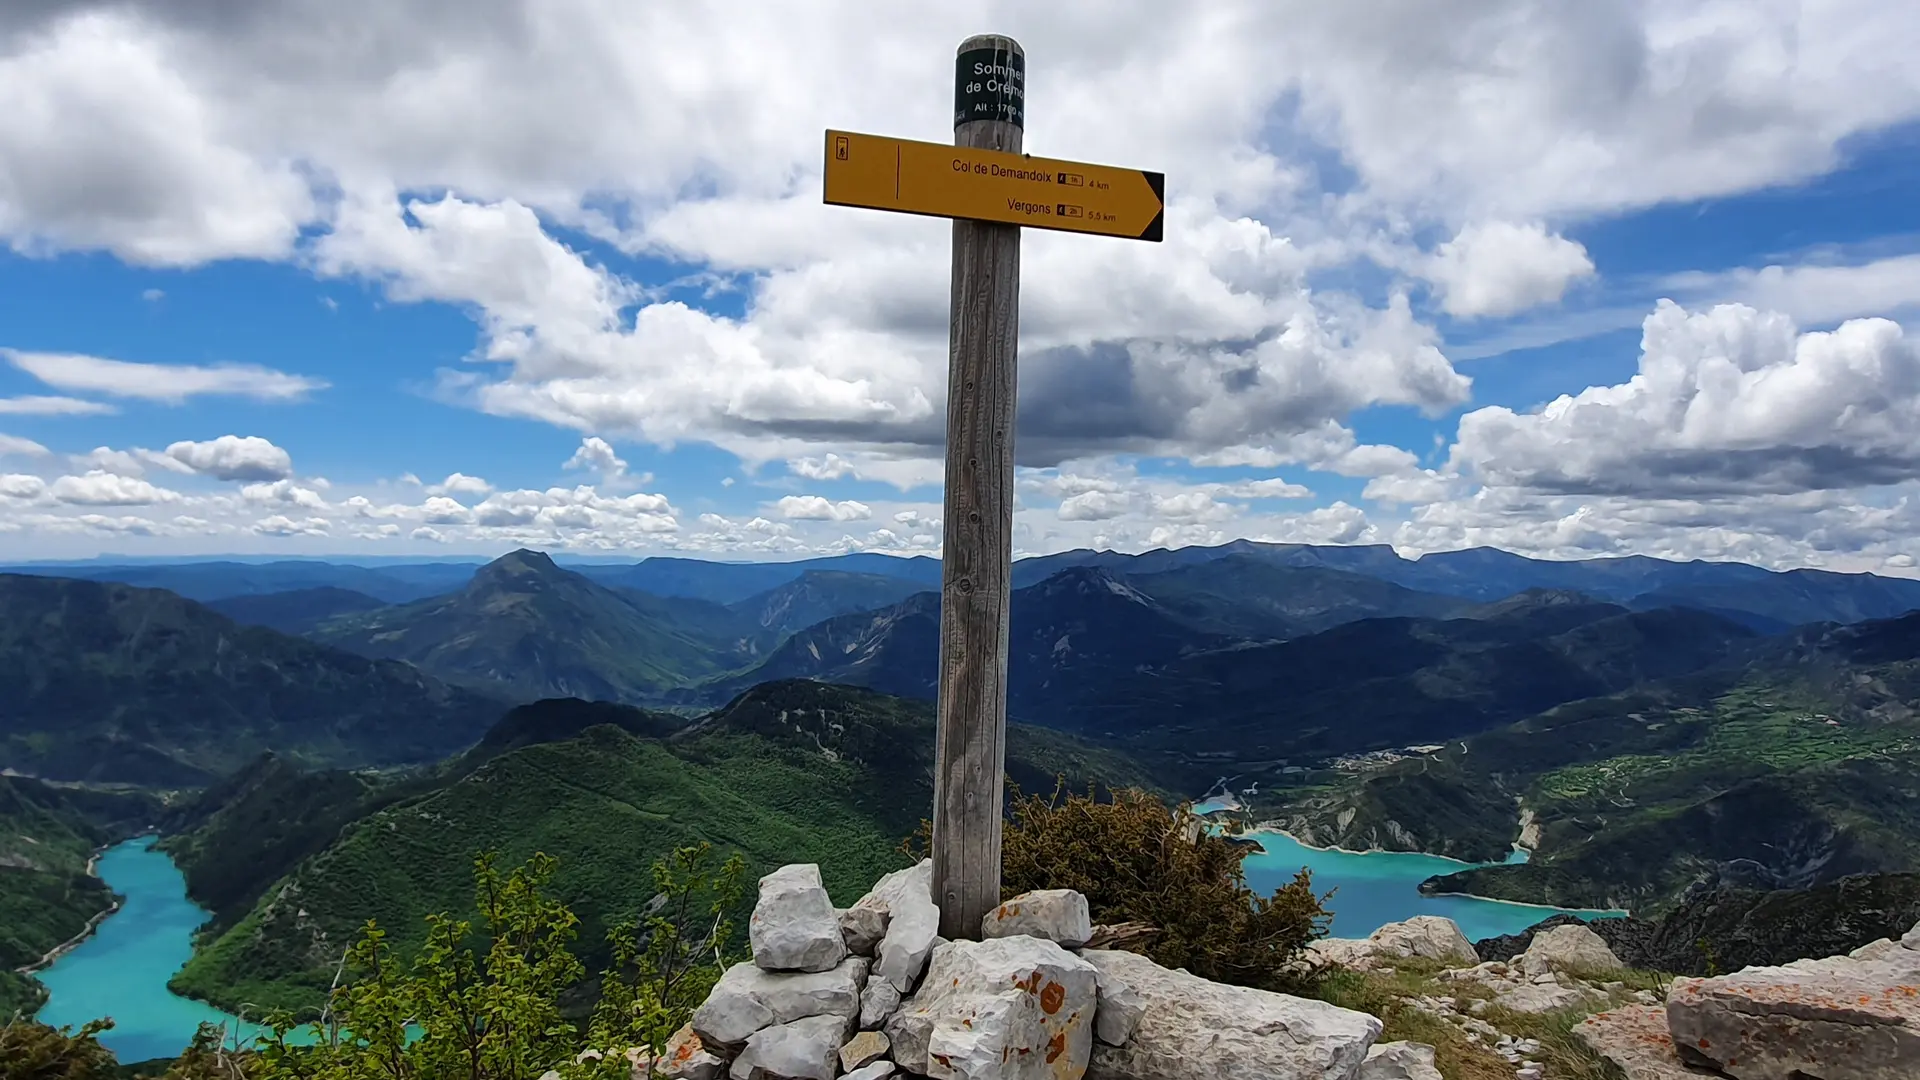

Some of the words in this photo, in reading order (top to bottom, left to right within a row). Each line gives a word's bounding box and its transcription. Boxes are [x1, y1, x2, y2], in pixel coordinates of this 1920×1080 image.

[966, 81, 982, 94] de
[974, 103, 988, 112] Alt
[952, 159, 971, 173] Col
[974, 163, 988, 175] de
[991, 164, 1052, 183] Demandolx
[1089, 179, 1094, 188] 4
[1097, 181, 1109, 190] km
[1007, 198, 1051, 215] Vergons
[1103, 213, 1116, 222] km
